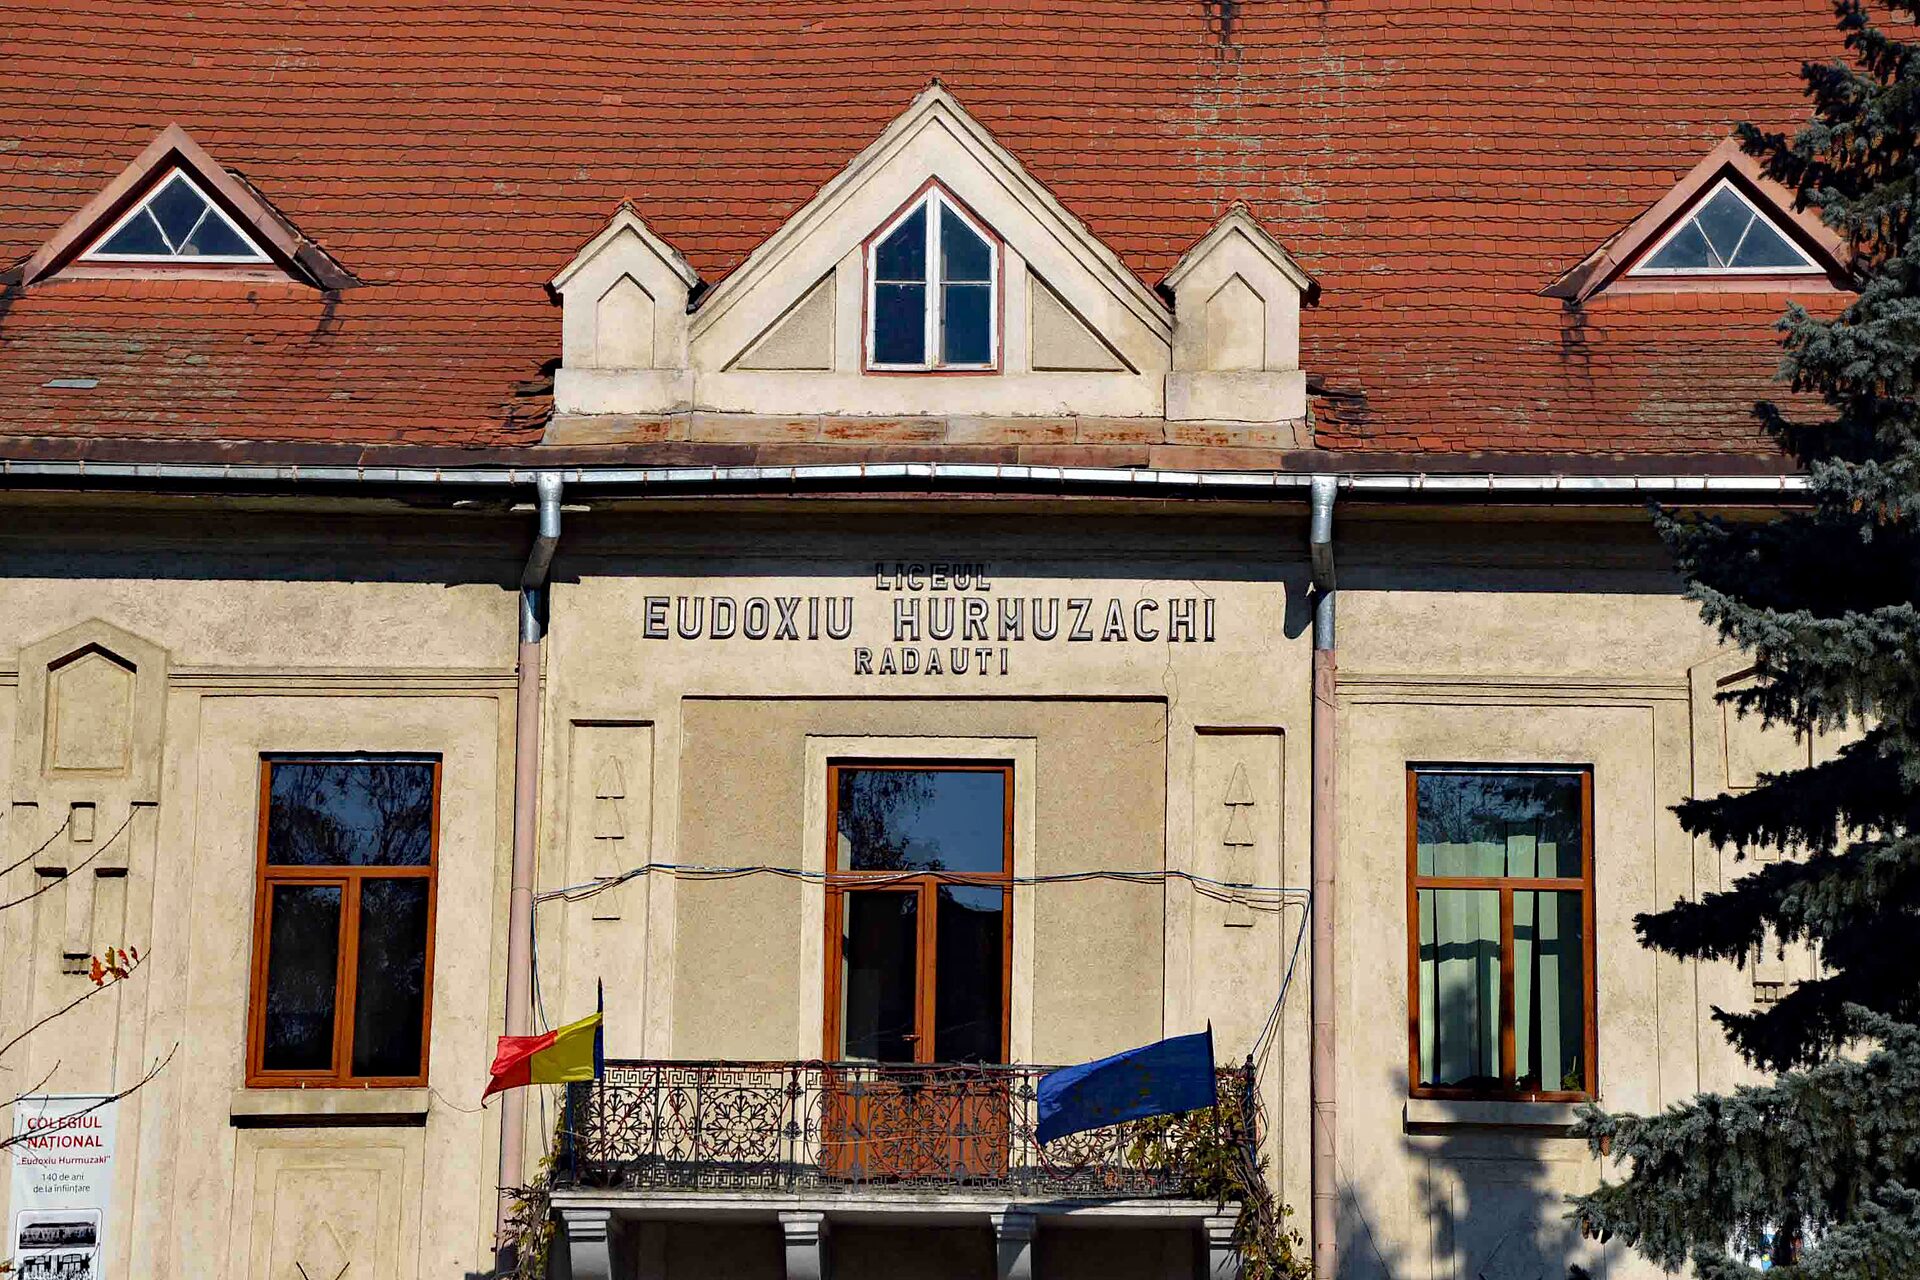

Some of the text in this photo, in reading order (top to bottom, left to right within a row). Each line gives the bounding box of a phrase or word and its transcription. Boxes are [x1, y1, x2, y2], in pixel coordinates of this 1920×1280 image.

[874, 563, 992, 591] LICEUL
[643, 596, 1217, 642] EUDOXIU HURMUZACHI
[854, 647, 1009, 675] RADAUTI
[27, 1117, 102, 1130] COLEGIUL
[42, 1172, 84, 1181] 140 de ani
[33, 1184, 43, 1193] de
[45, 1184, 53, 1193] la
